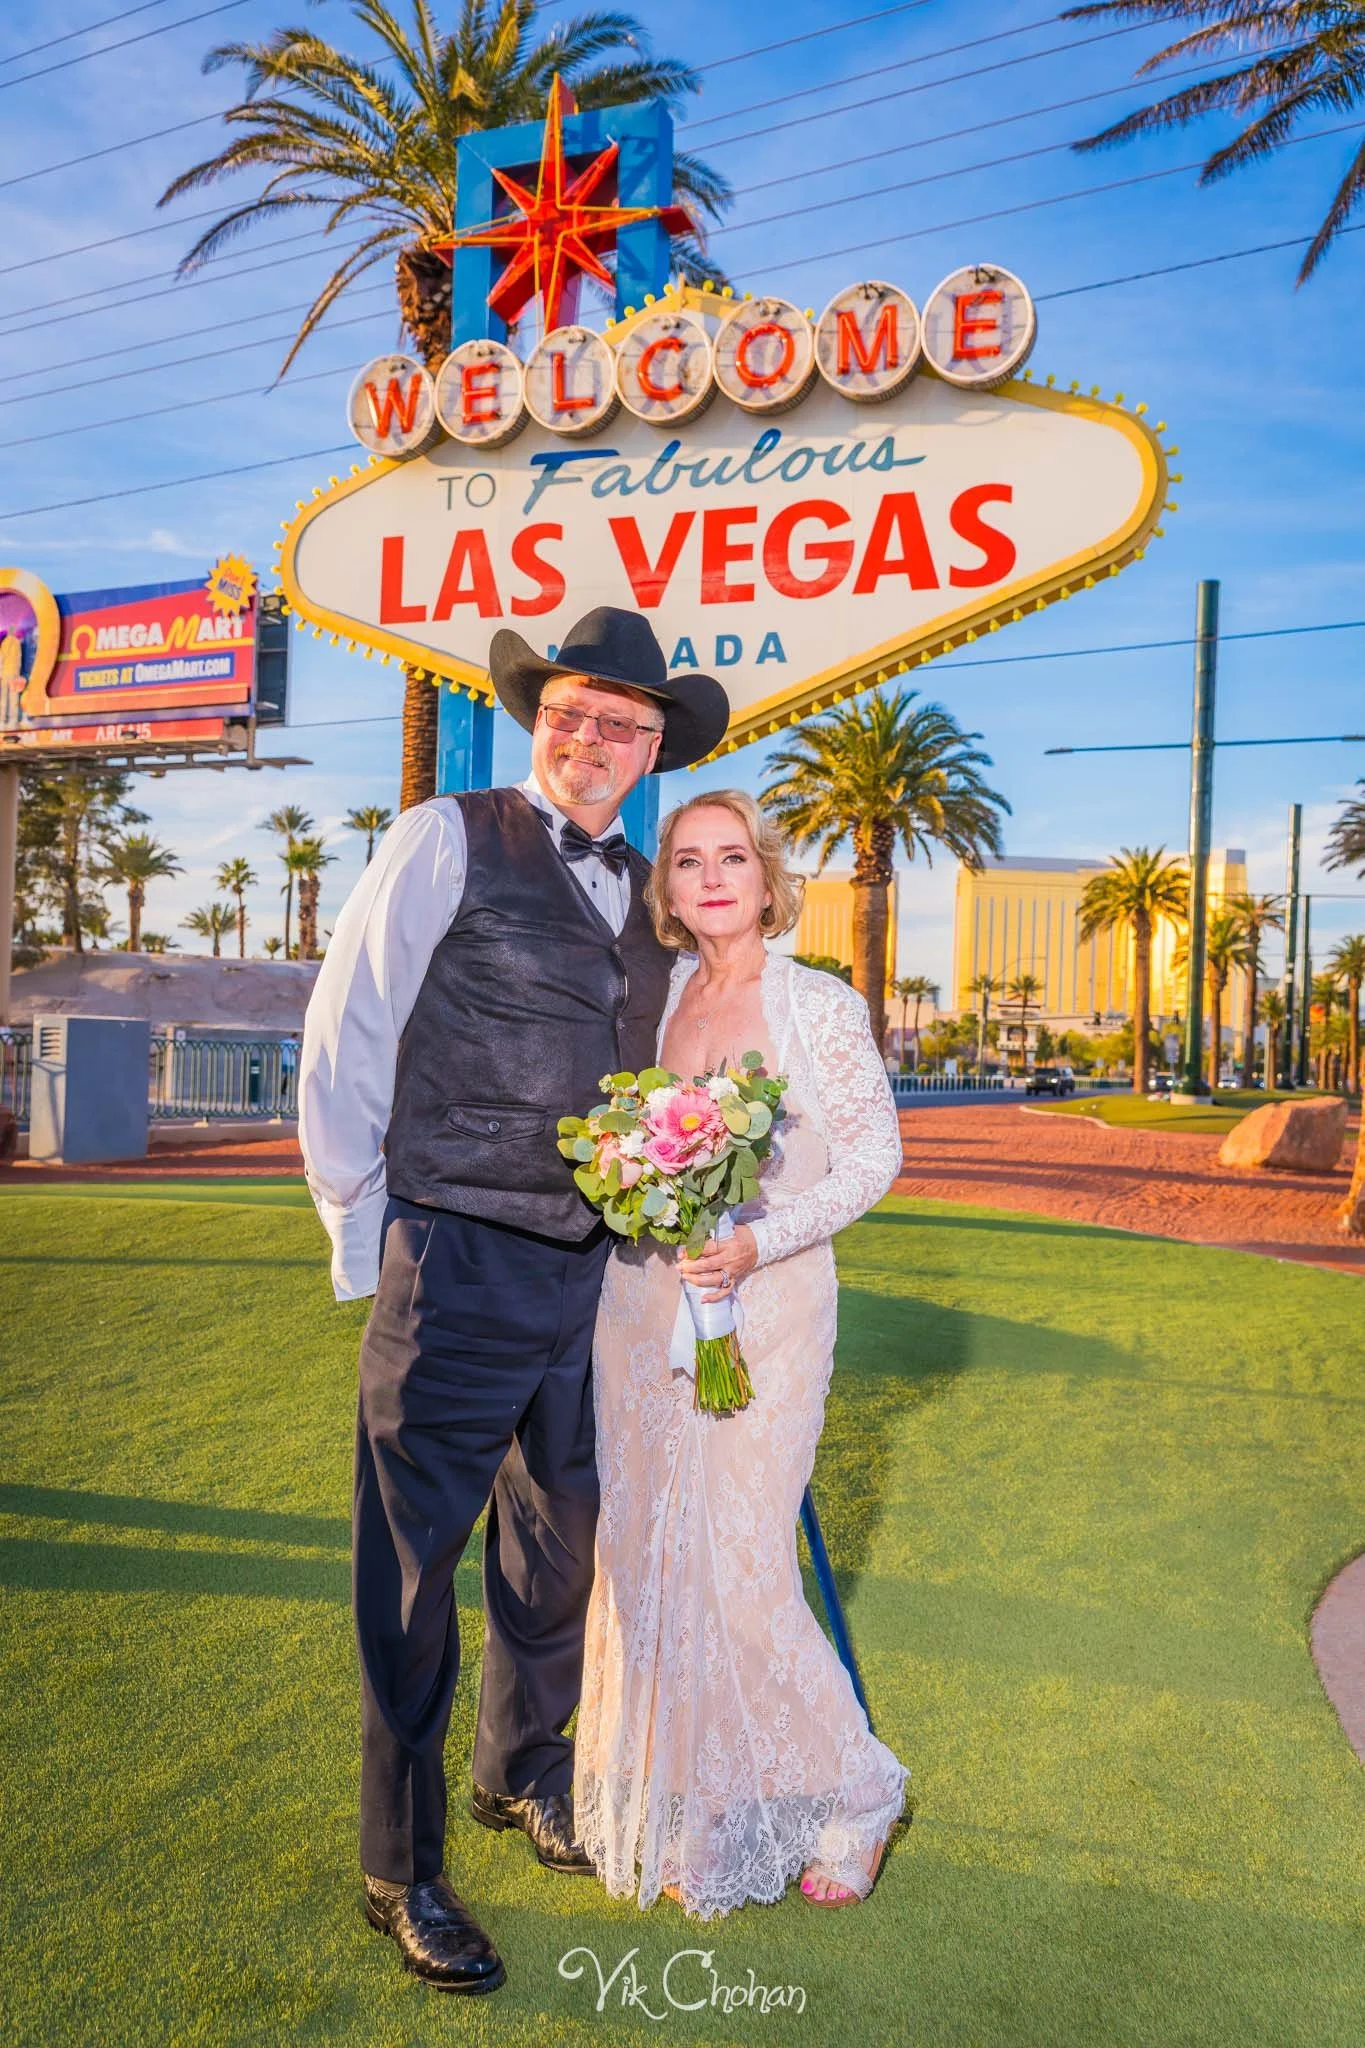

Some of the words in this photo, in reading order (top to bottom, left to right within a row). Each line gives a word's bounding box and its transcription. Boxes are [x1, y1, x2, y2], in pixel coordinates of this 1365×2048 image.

[364, 289, 1003, 438] WELCOME
[438, 471, 497, 511] TO
[522, 428, 927, 516] Fabulous
[379, 521, 568, 625] LAS
[608, 483, 1017, 609] VEGAS
[168, 614, 245, 651] MART
[547, 631, 788, 669] ADA
